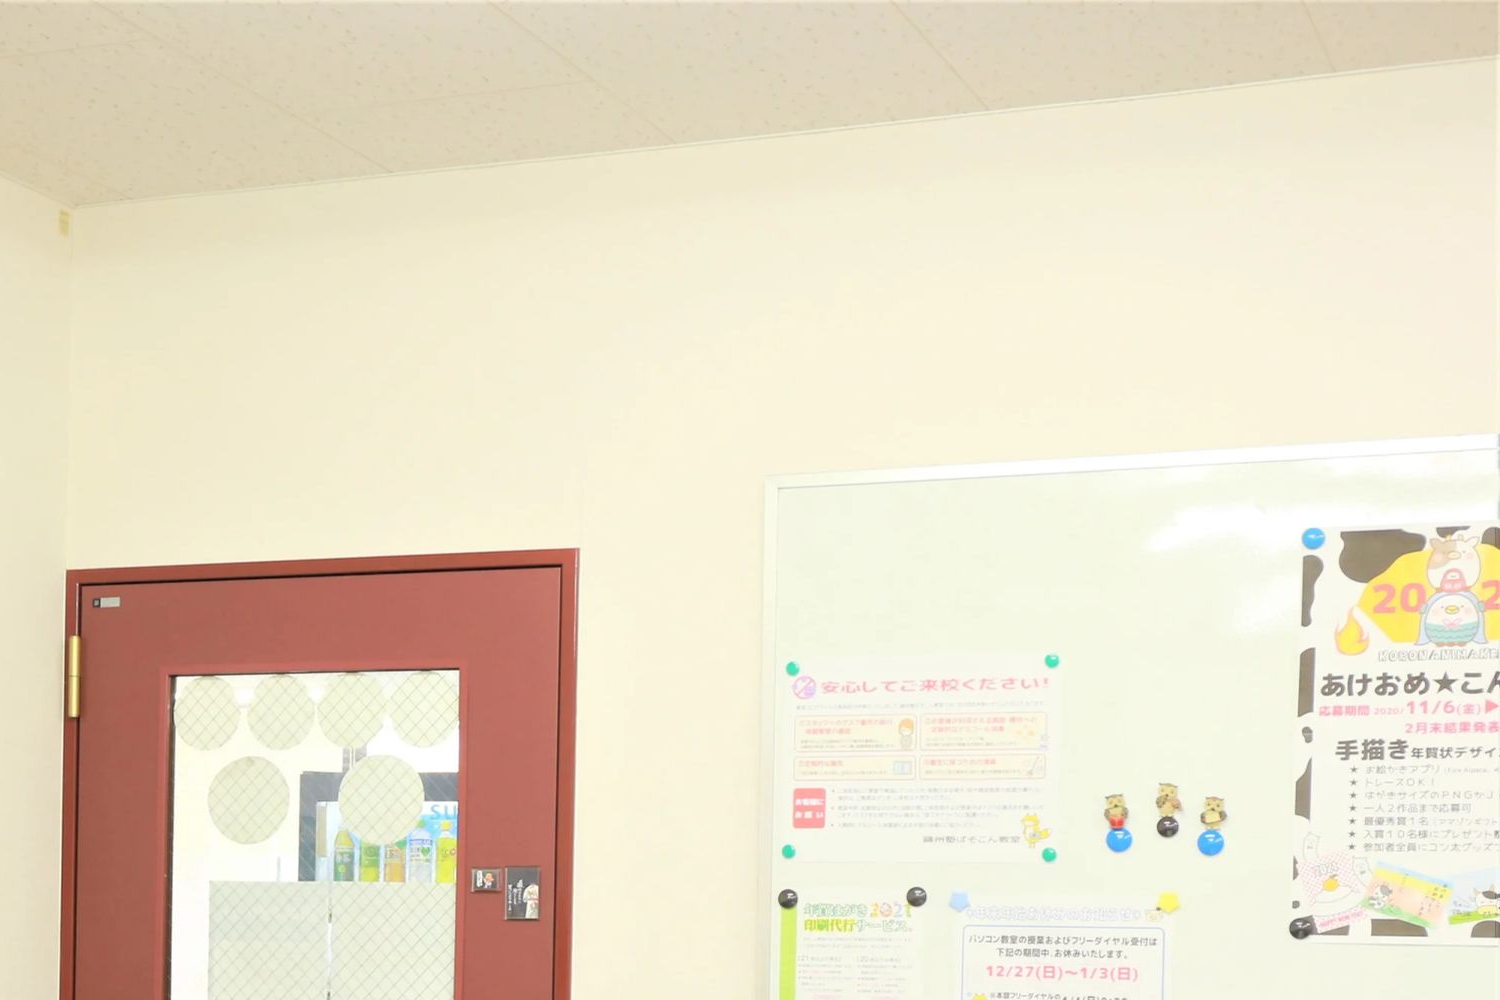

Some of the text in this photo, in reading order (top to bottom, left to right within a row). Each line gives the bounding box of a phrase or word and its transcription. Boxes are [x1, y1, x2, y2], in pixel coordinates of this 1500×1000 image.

[821, 677, 1049, 694] 安心してご来校ください!
[1318, 704, 1370, 717] 応募期間
[1335, 738, 1500, 762] 手描き年賀状デザイ
[1365, 790, 1500, 800] はがきサイズのPNGかJ
[969, 935, 1157, 947] パソコン教室の授業およびフリーダイヤル受付は
